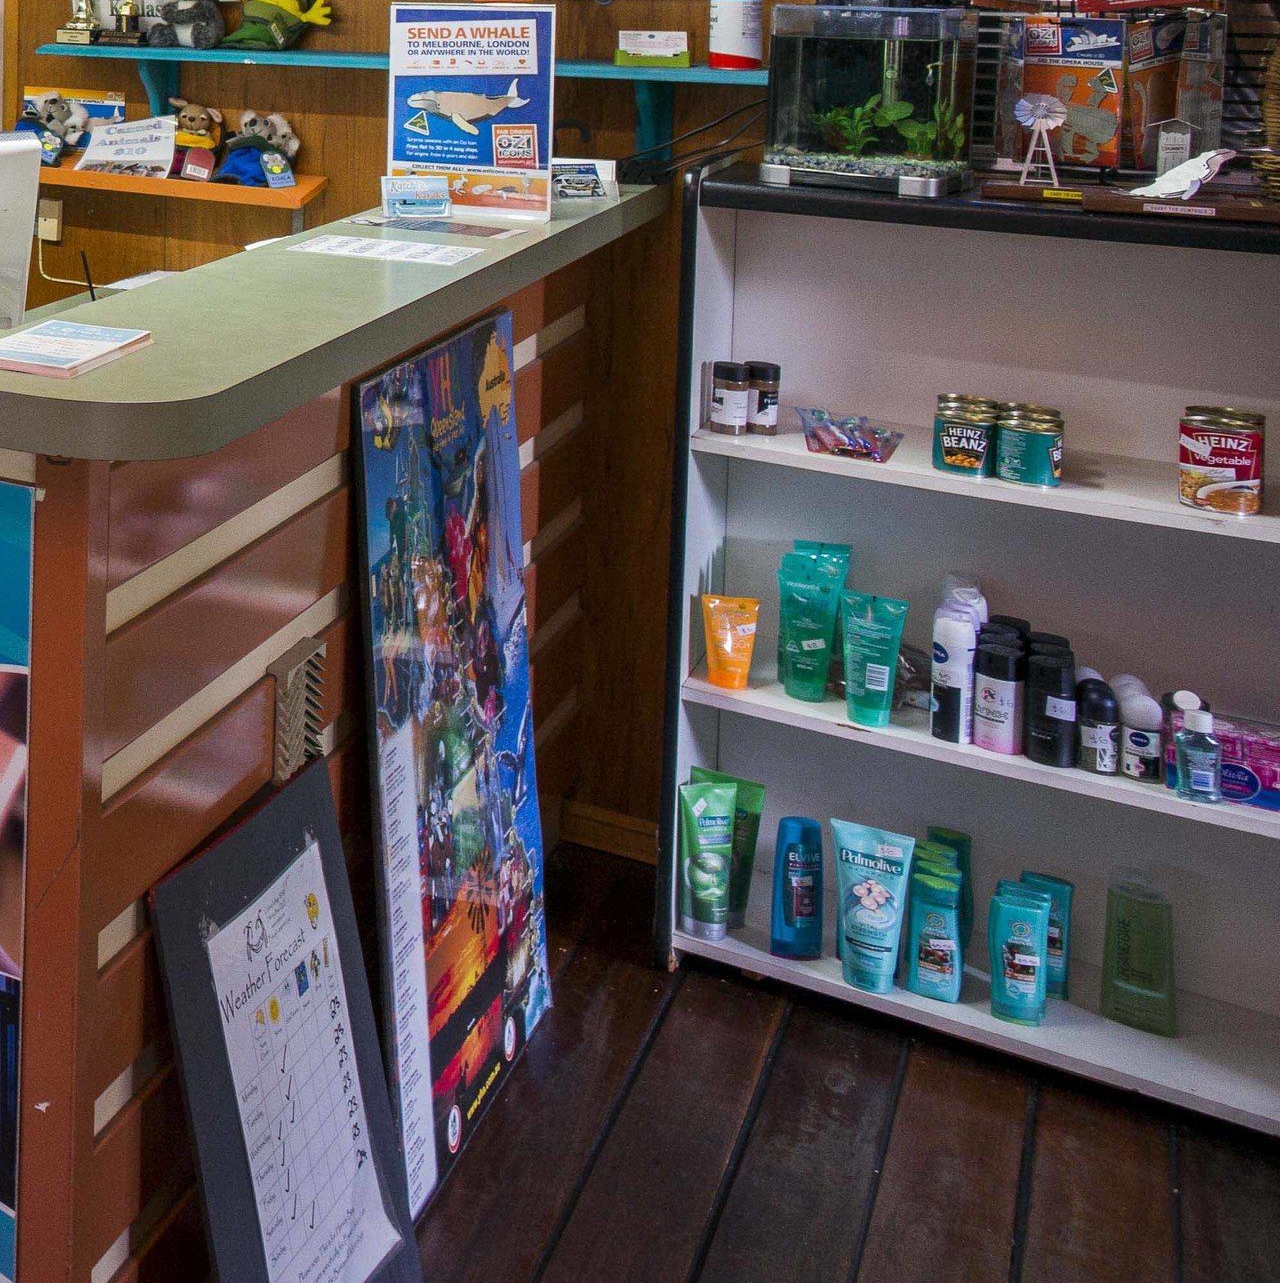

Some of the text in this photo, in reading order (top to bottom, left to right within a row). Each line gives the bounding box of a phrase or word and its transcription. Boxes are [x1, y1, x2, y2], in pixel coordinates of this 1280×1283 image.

[407, 26, 530, 39] SEND A WHALE
[407, 40, 530, 49] TO MELBOURNE, LONDON
[104, 120, 163, 136] Canned
[97, 133, 162, 148] Animals
[497, 135, 532, 151] OZI
[498, 149, 532, 158] ICONS
[948, 427, 983, 439] HEINZ
[942, 436, 987, 452] BEANZ
[1197, 436, 1249, 452] HEINZ
[841, 848, 902, 875] Palmolive
[220, 969, 266, 1025] Weather
[266, 929, 306, 975] Forecast
